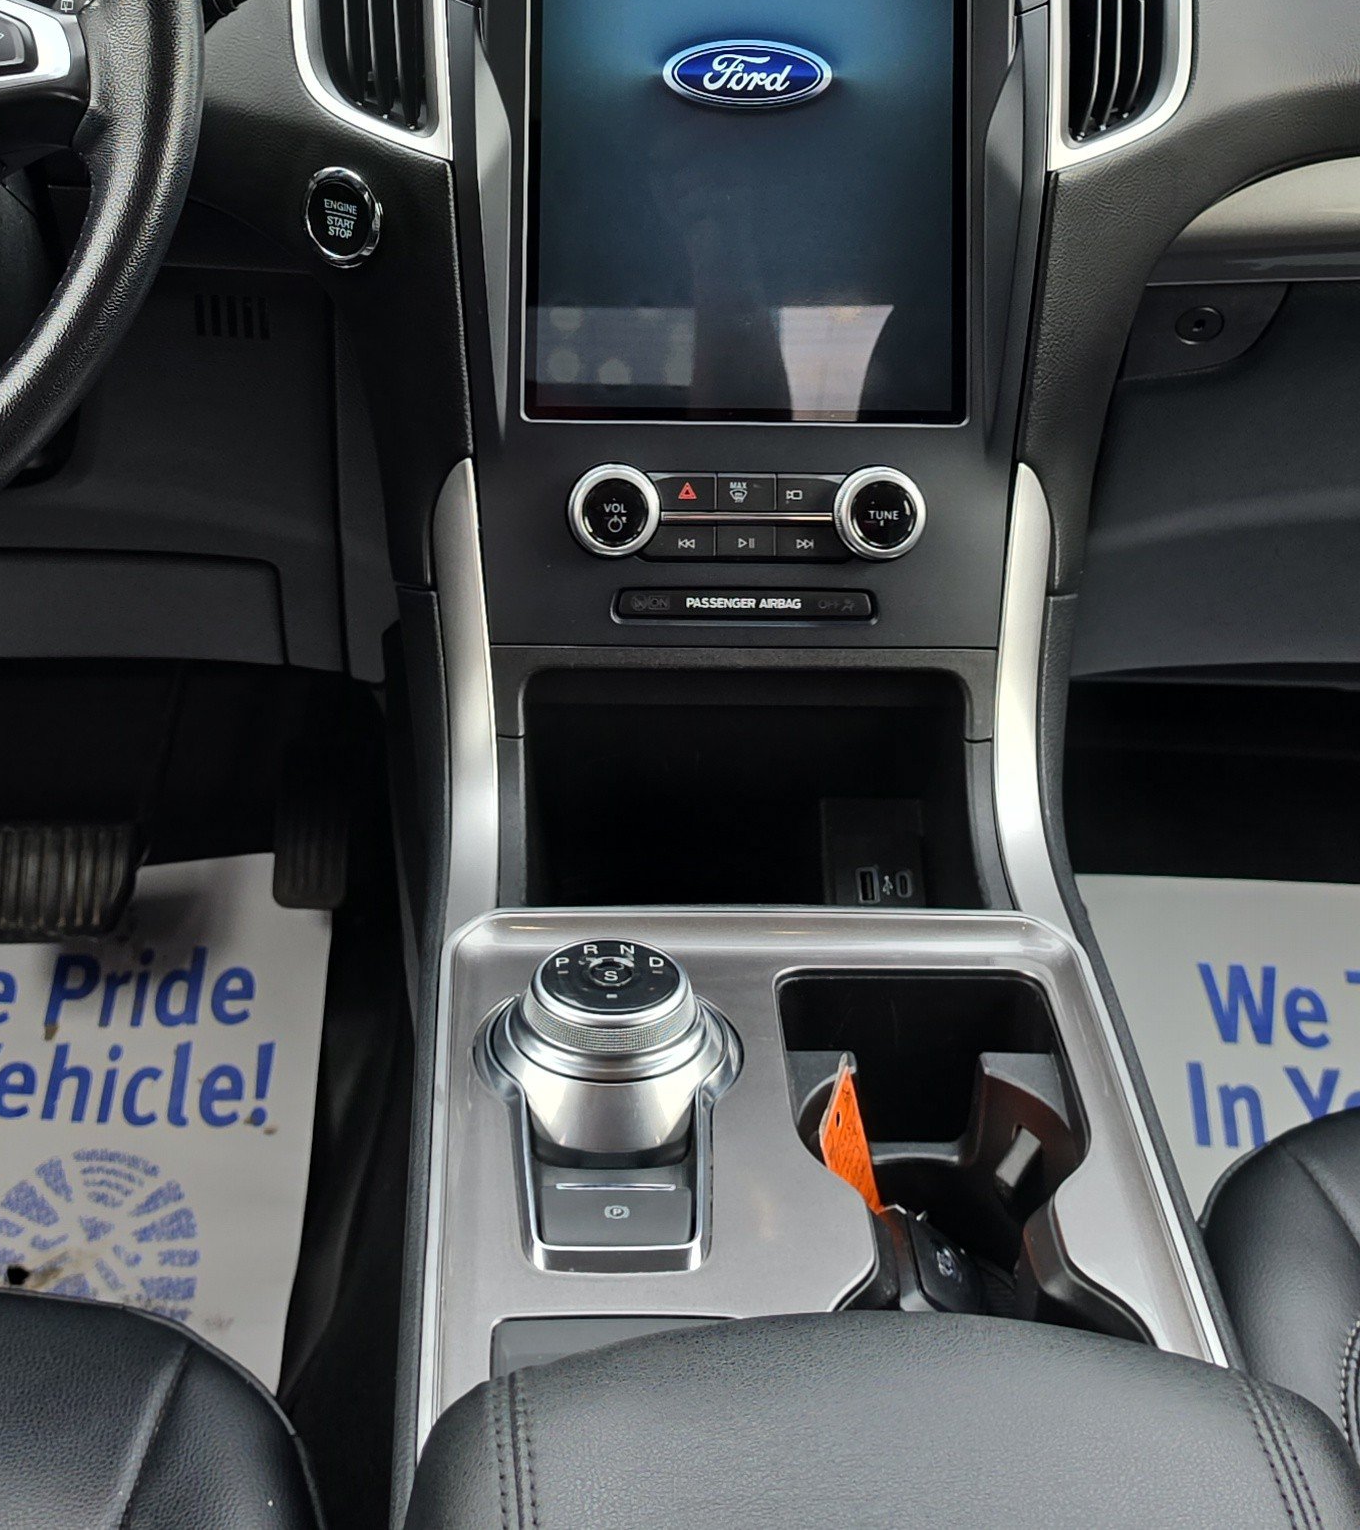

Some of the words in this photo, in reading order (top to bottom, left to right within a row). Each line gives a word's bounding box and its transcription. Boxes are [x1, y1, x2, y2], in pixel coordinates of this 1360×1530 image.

[703, 53, 793, 92] Ford
[323, 198, 358, 215] ENGINE
[326, 215, 355, 230] START
[328, 226, 353, 239] STOP
[729, 482, 747, 491] MAX
[603, 503, 628, 514] VOL
[868, 509, 900, 521] TUNE
[685, 597, 756, 609] PASSENGER
[758, 598, 802, 609] AIRBAG
[583, 944, 598, 955] R
[620, 944, 635, 955] N
[555, 957, 569, 968] P
[648, 956, 664, 967] D
[604, 970, 618, 981] S
[45, 945, 257, 1028] Pride
[1197, 963, 1329, 1049] We
[1186, 1062, 1269, 1150] In
